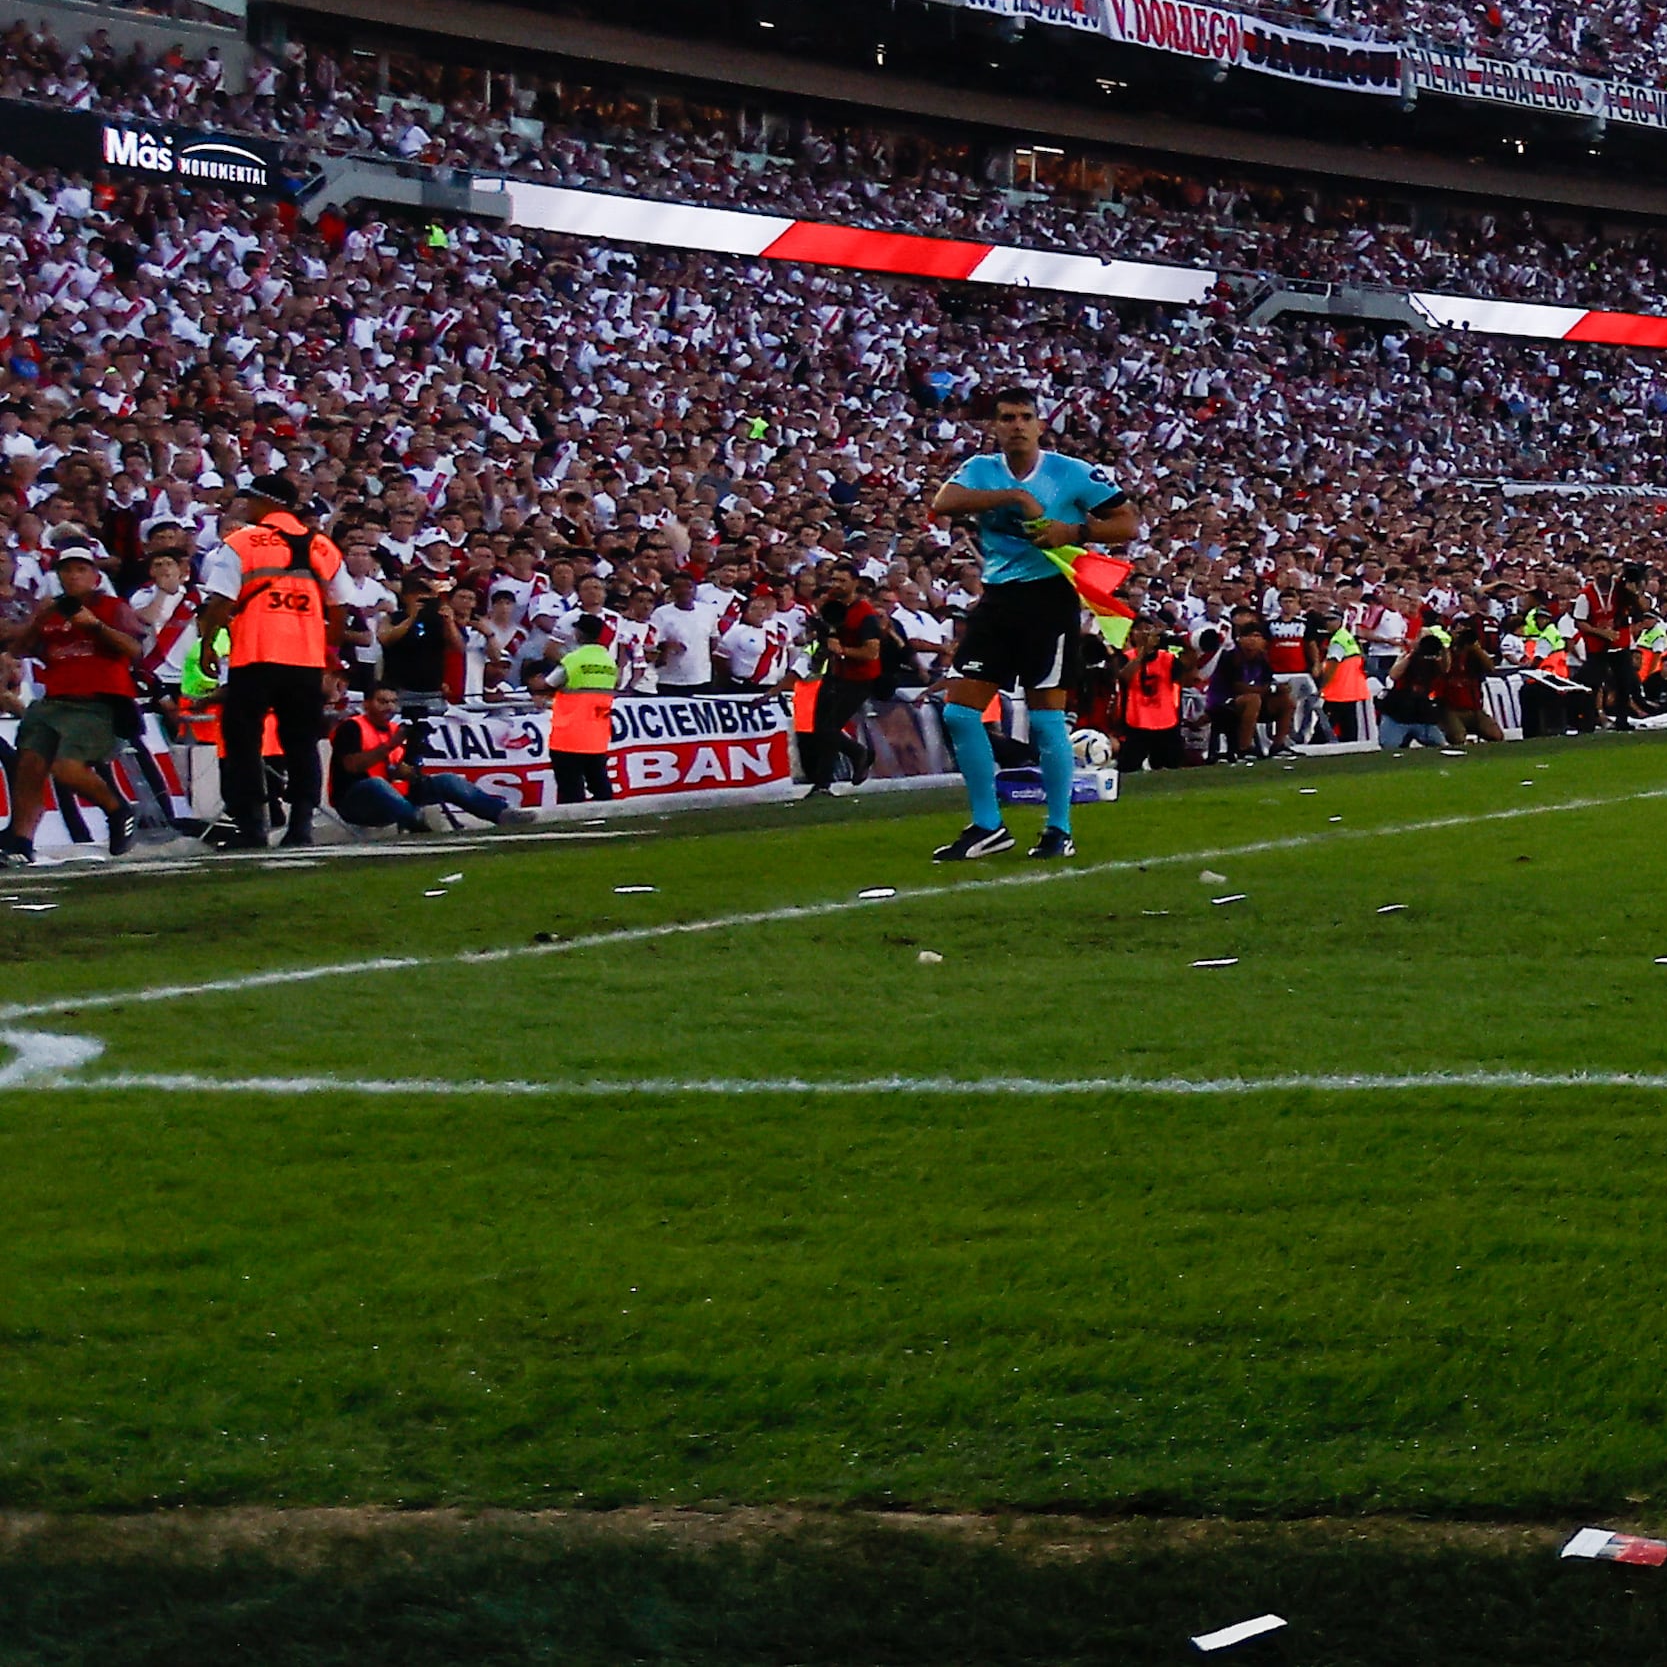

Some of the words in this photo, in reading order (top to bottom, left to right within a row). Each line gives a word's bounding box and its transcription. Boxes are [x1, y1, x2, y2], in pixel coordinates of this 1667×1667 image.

[1408, 47, 1476, 96] FILIAL
[177, 157, 268, 186] MONUMENTAL
[526, 720, 545, 757] 9
[610, 700, 778, 743] DICIEMBRE
